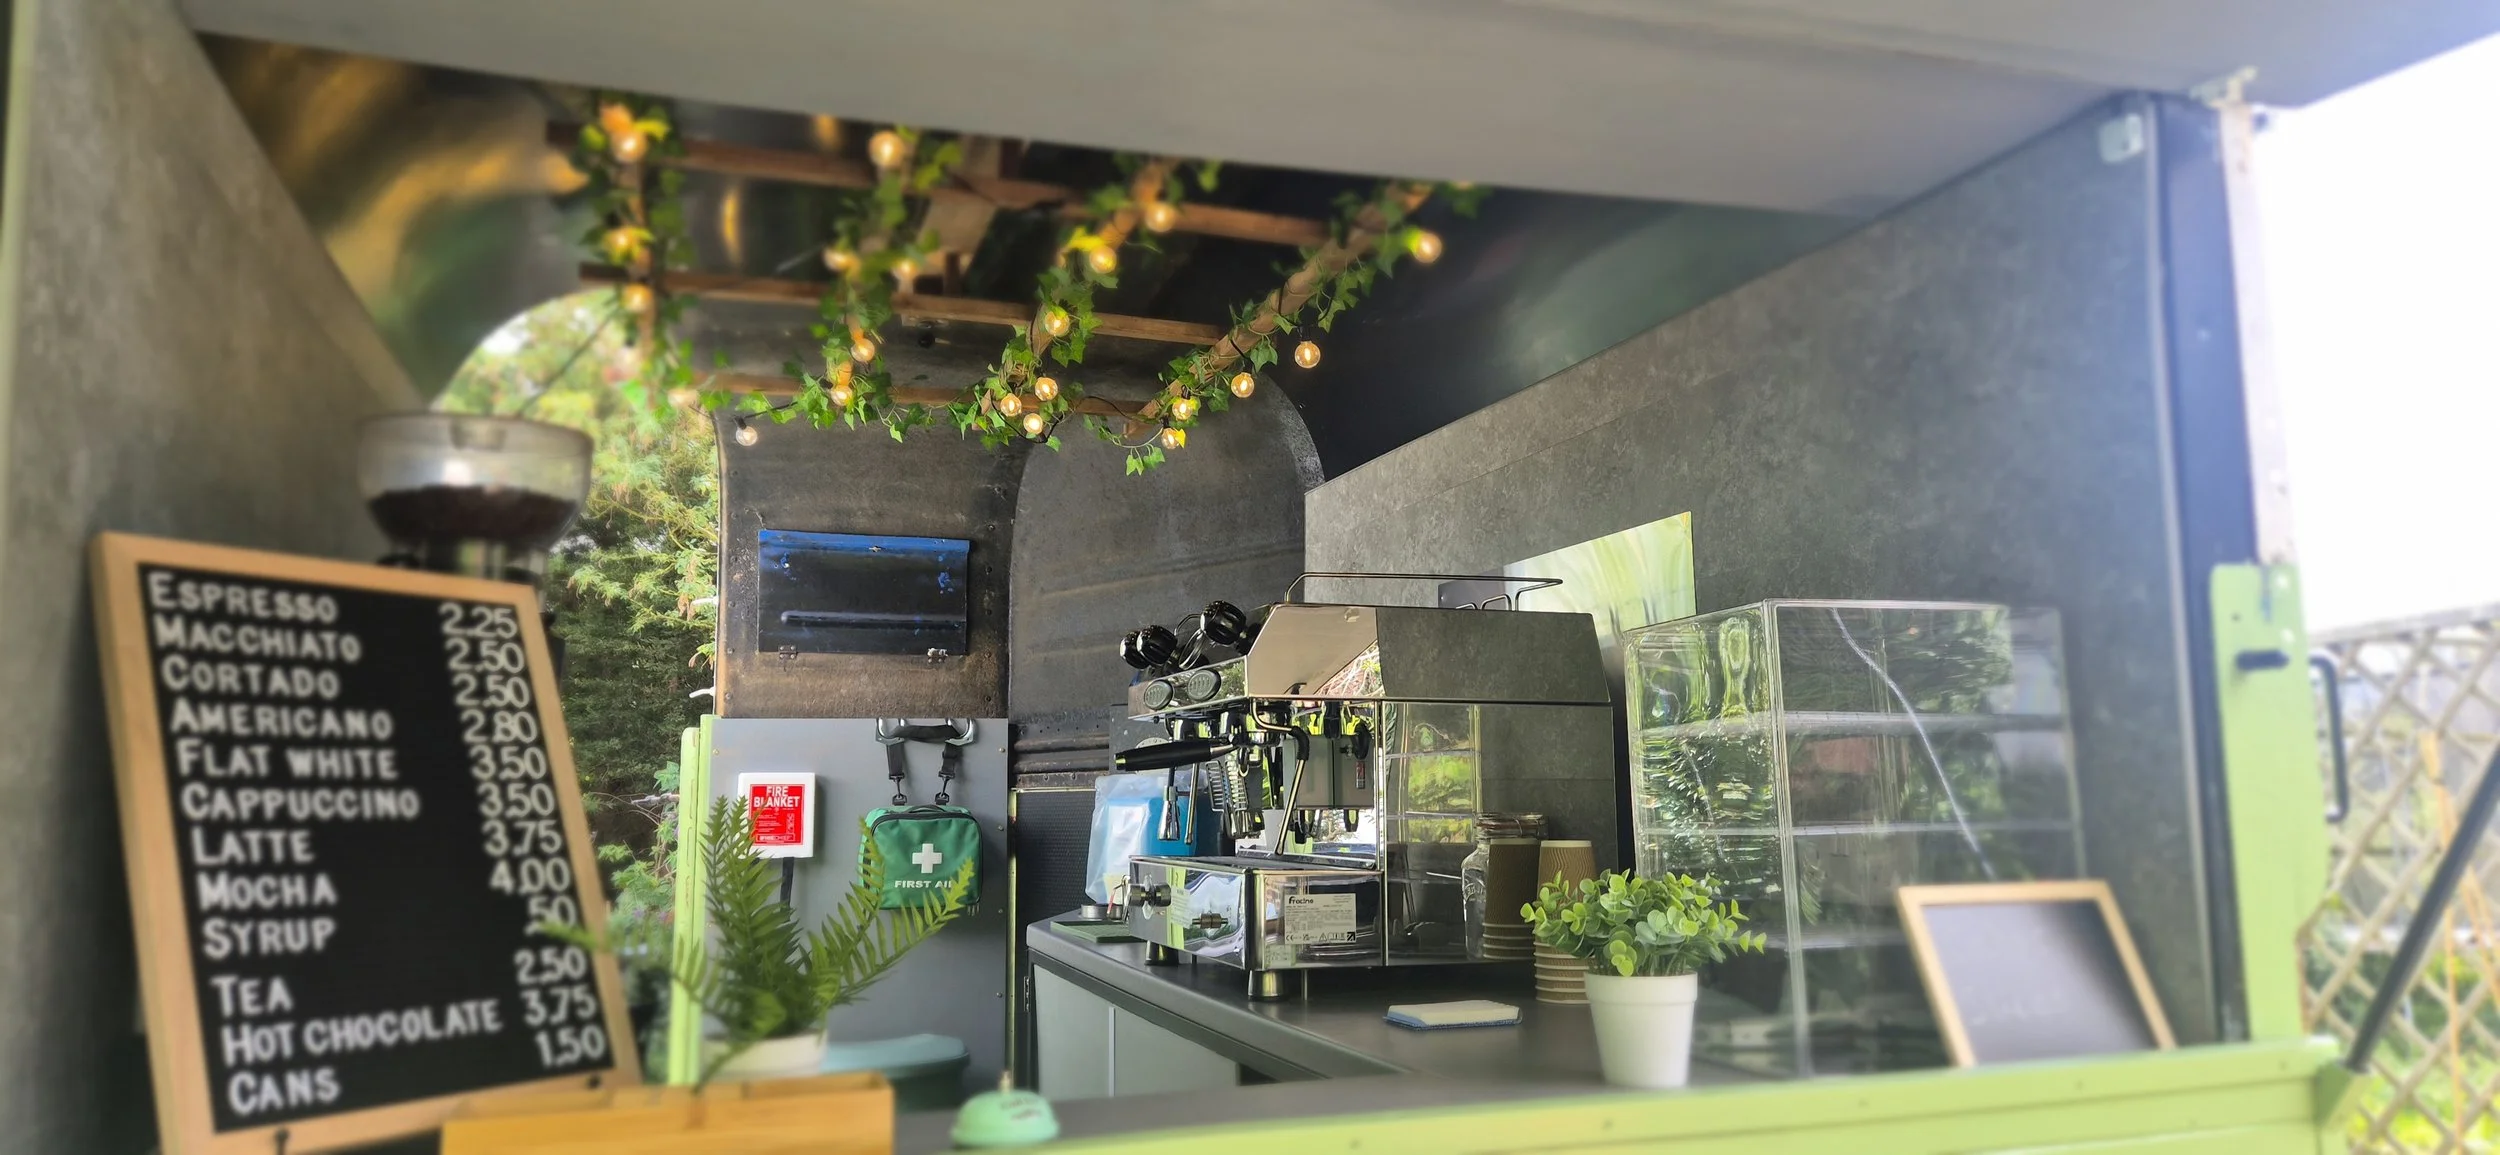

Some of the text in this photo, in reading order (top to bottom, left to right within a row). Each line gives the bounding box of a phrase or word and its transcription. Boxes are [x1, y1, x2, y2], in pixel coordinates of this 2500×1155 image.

[148, 572, 517, 638] ESPRESSO 2.25
[153, 612, 525, 673] MACCHIATO 2.50
[161, 653, 530, 708] CORTADO 2.50
[170, 695, 537, 743] AMERICANO 2.80
[176, 737, 547, 781] FLAT WHITE 3.50
[180, 782, 555, 821] CAPPUCCINO 3.50
[766, 786, 789, 796] FIRE
[190, 820, 561, 866] LATTE 3.75
[197, 857, 570, 910] MOCHA 4.00
[894, 880, 952, 888] FIRST AI
[202, 915, 338, 960] SYRUP
[210, 947, 586, 1018] TEA 2.50
[219, 985, 597, 1067] HOT CHOCOLATE 3.75
[227, 1025, 605, 1118] CANS 1.50
